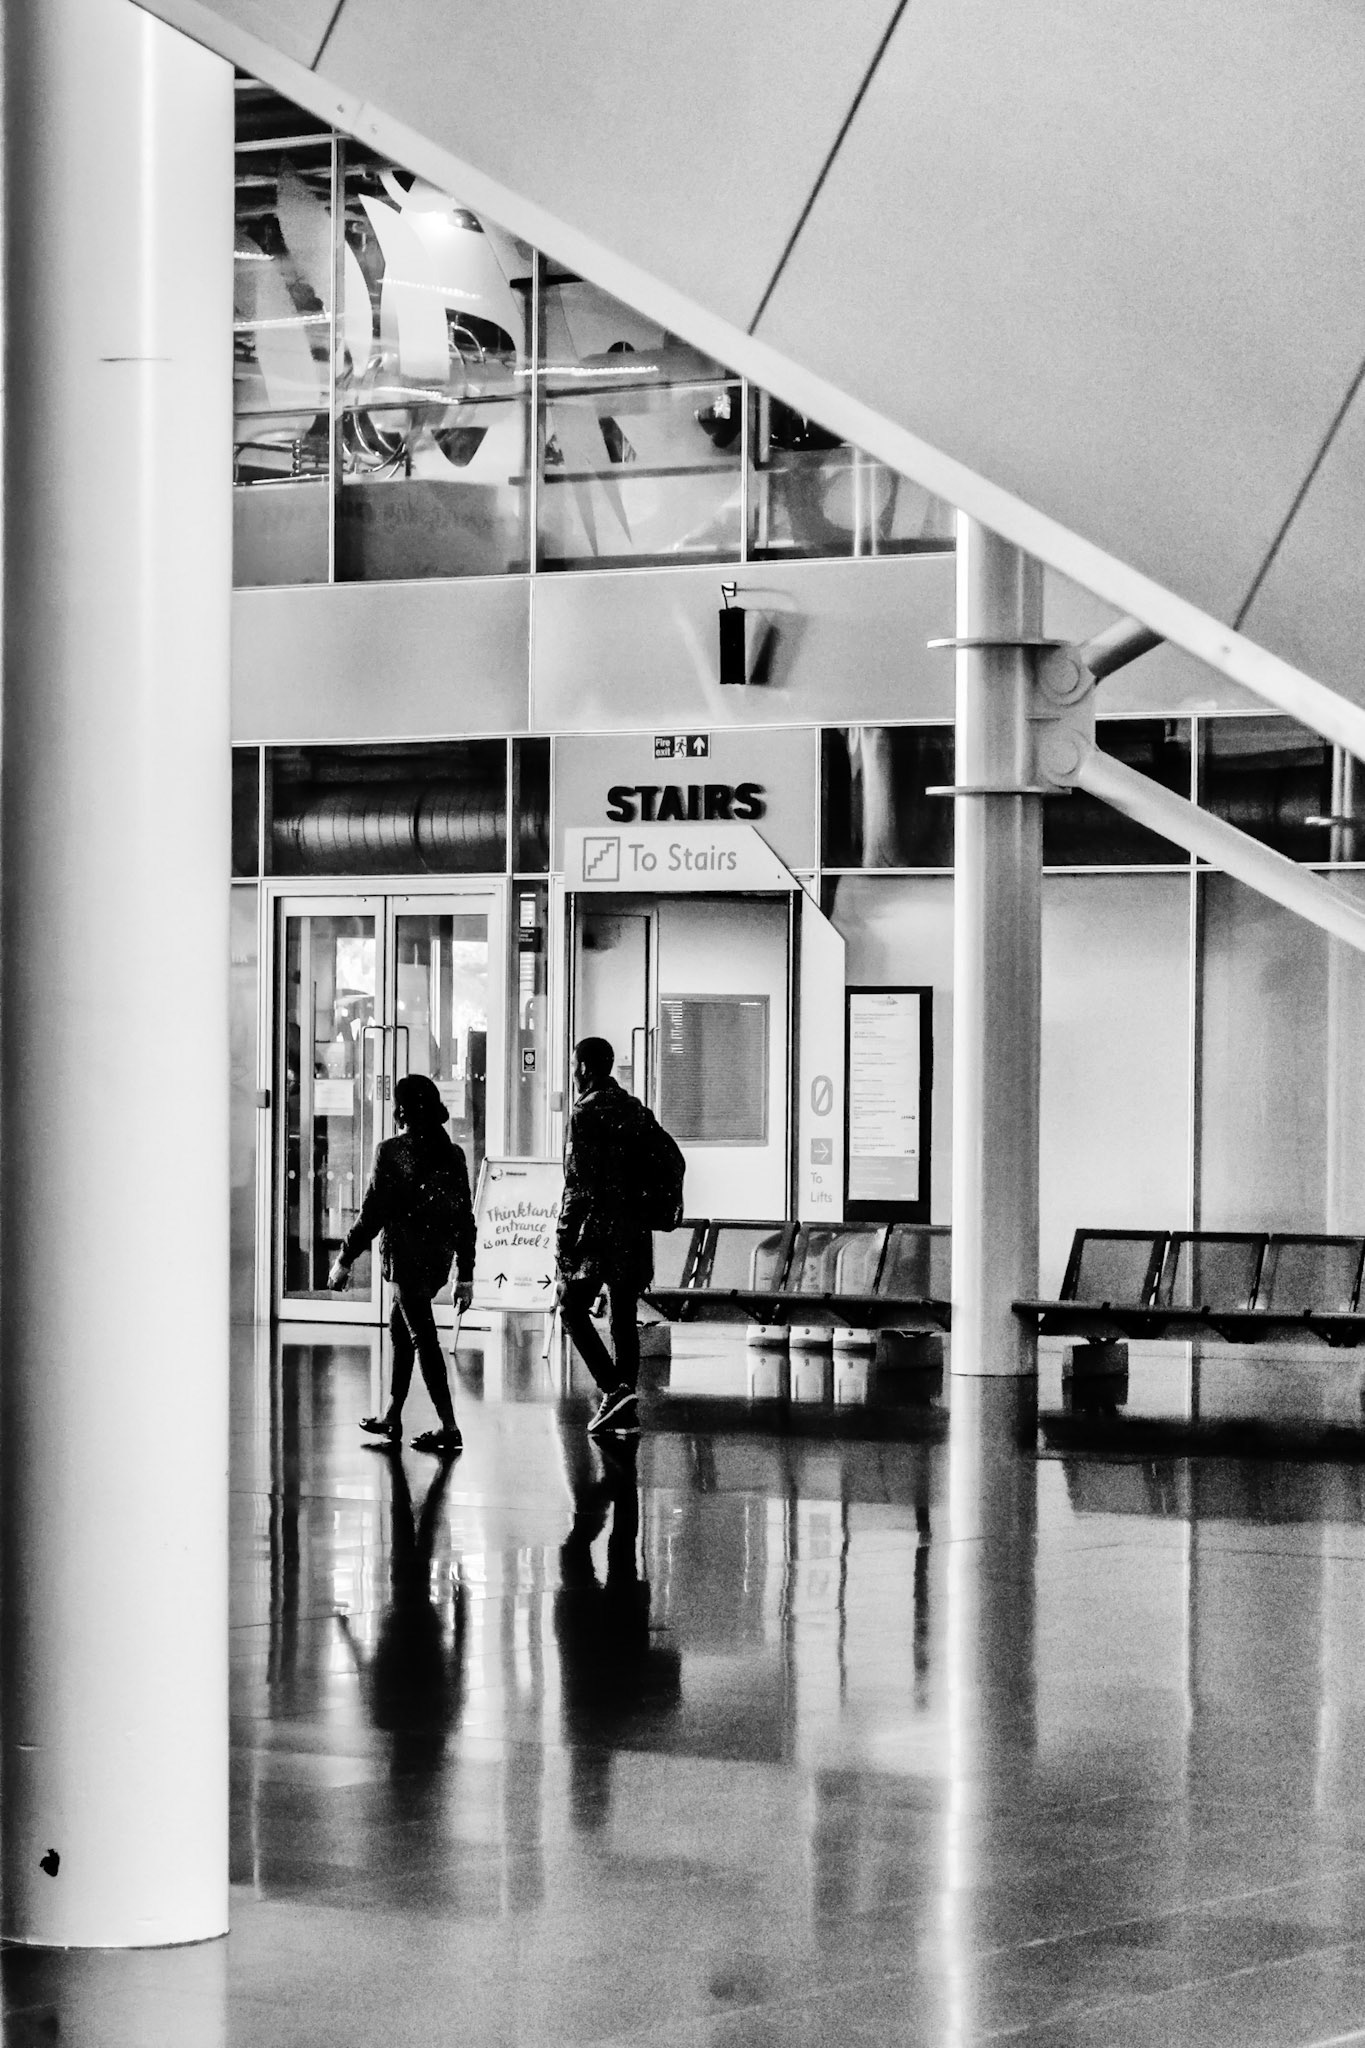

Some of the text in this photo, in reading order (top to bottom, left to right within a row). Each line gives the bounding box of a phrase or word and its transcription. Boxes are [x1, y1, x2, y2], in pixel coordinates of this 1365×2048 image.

[655, 738, 671, 747] Fire
[655, 747, 671, 757] exit
[606, 782, 766, 823] STAIRS
[628, 843, 737, 872] To Stairs
[810, 1075, 834, 1117] 0
[810, 1172, 823, 1184] To
[810, 1191, 833, 1204] Lifts
[486, 1201, 559, 1222] Thinktank
[495, 1219, 547, 1235] entrance
[483, 1233, 550, 1249] is on Level 2
